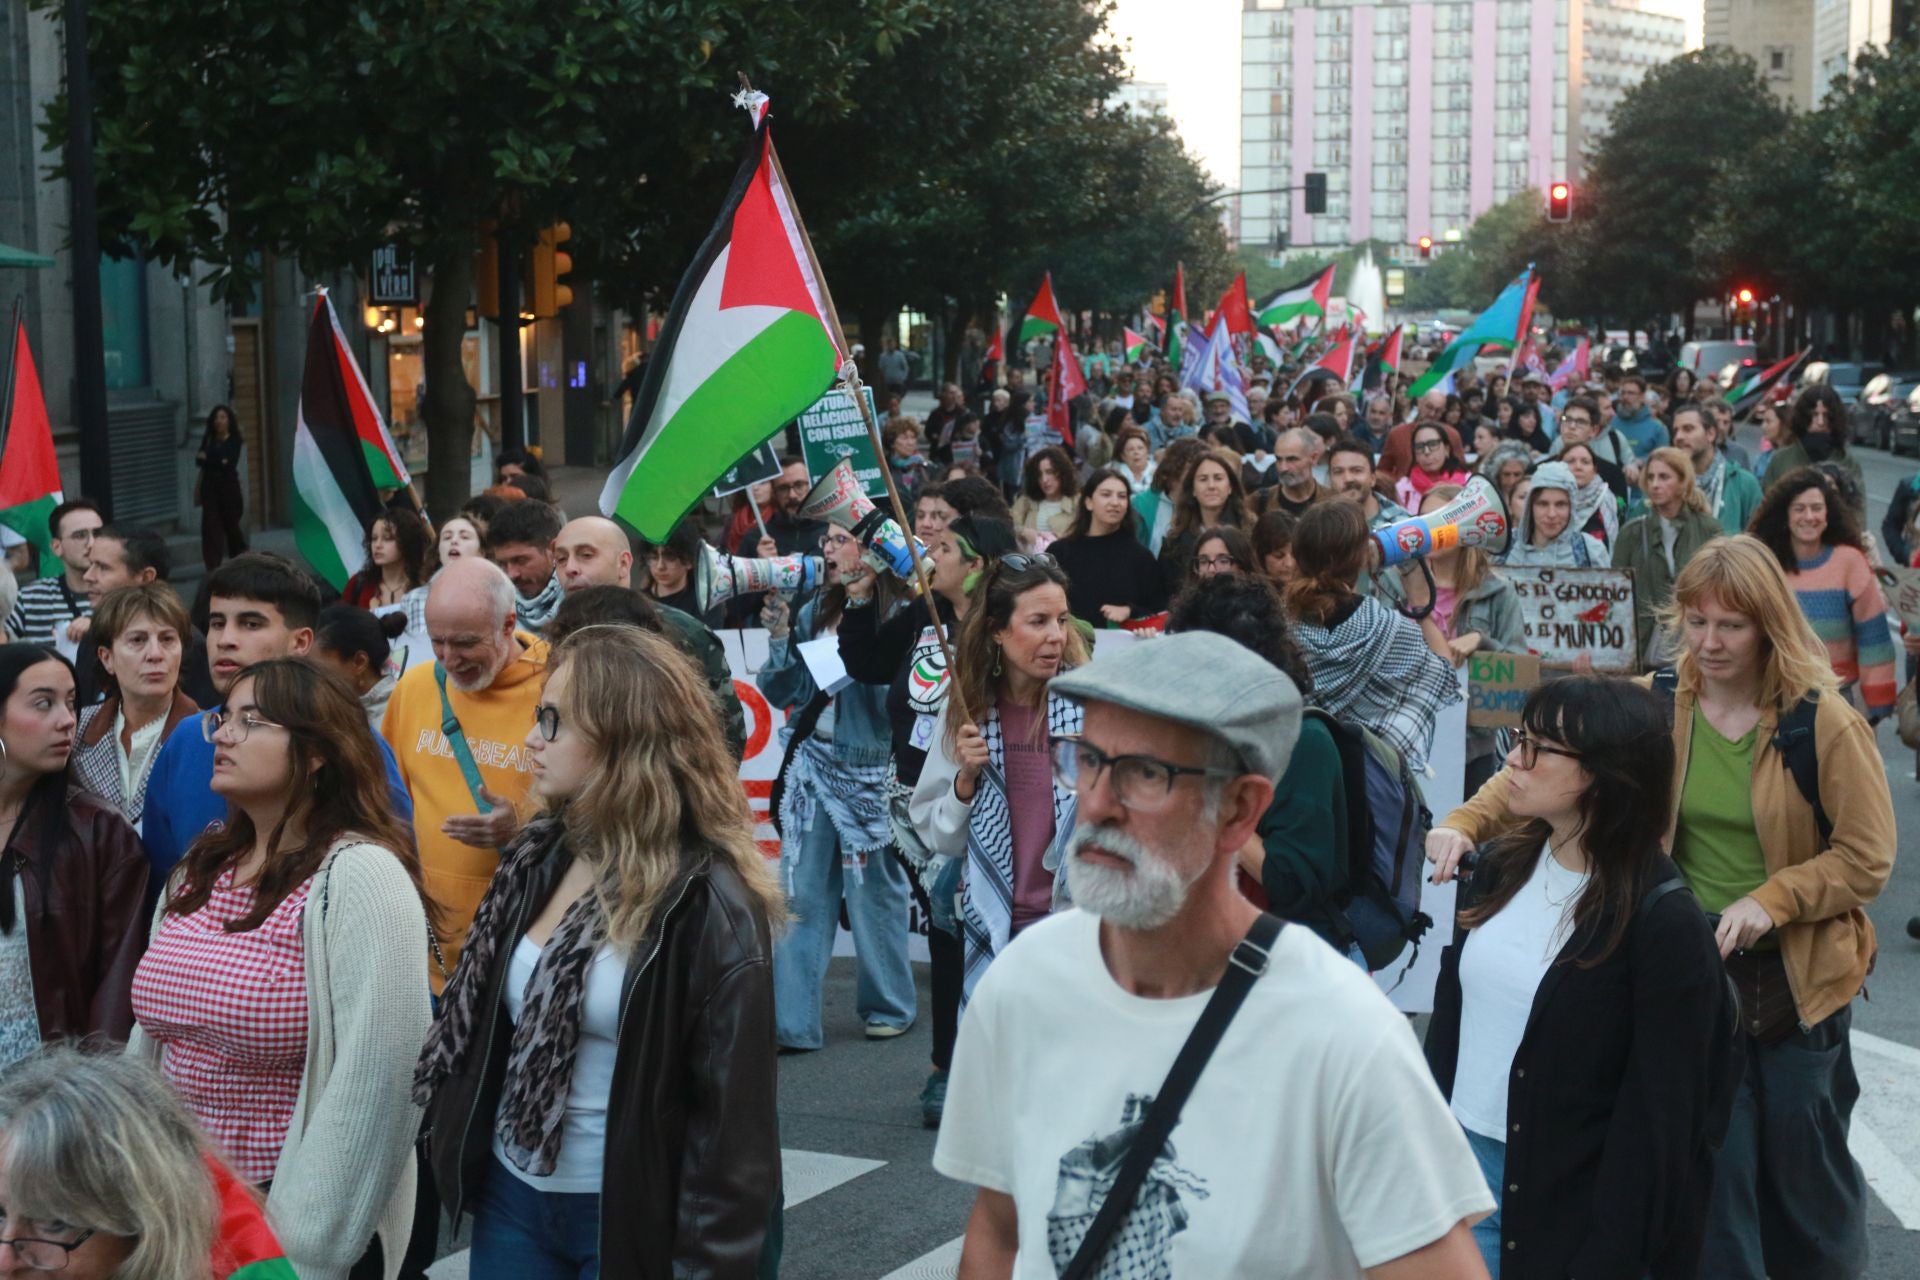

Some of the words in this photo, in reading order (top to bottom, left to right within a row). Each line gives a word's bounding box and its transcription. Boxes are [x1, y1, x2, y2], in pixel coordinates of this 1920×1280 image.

[807, 427, 831, 442] CON
[833, 422, 868, 439] ISRAE
[1554, 622, 1625, 649] MUNDO
[416, 728, 536, 773] PUL&BEAR
